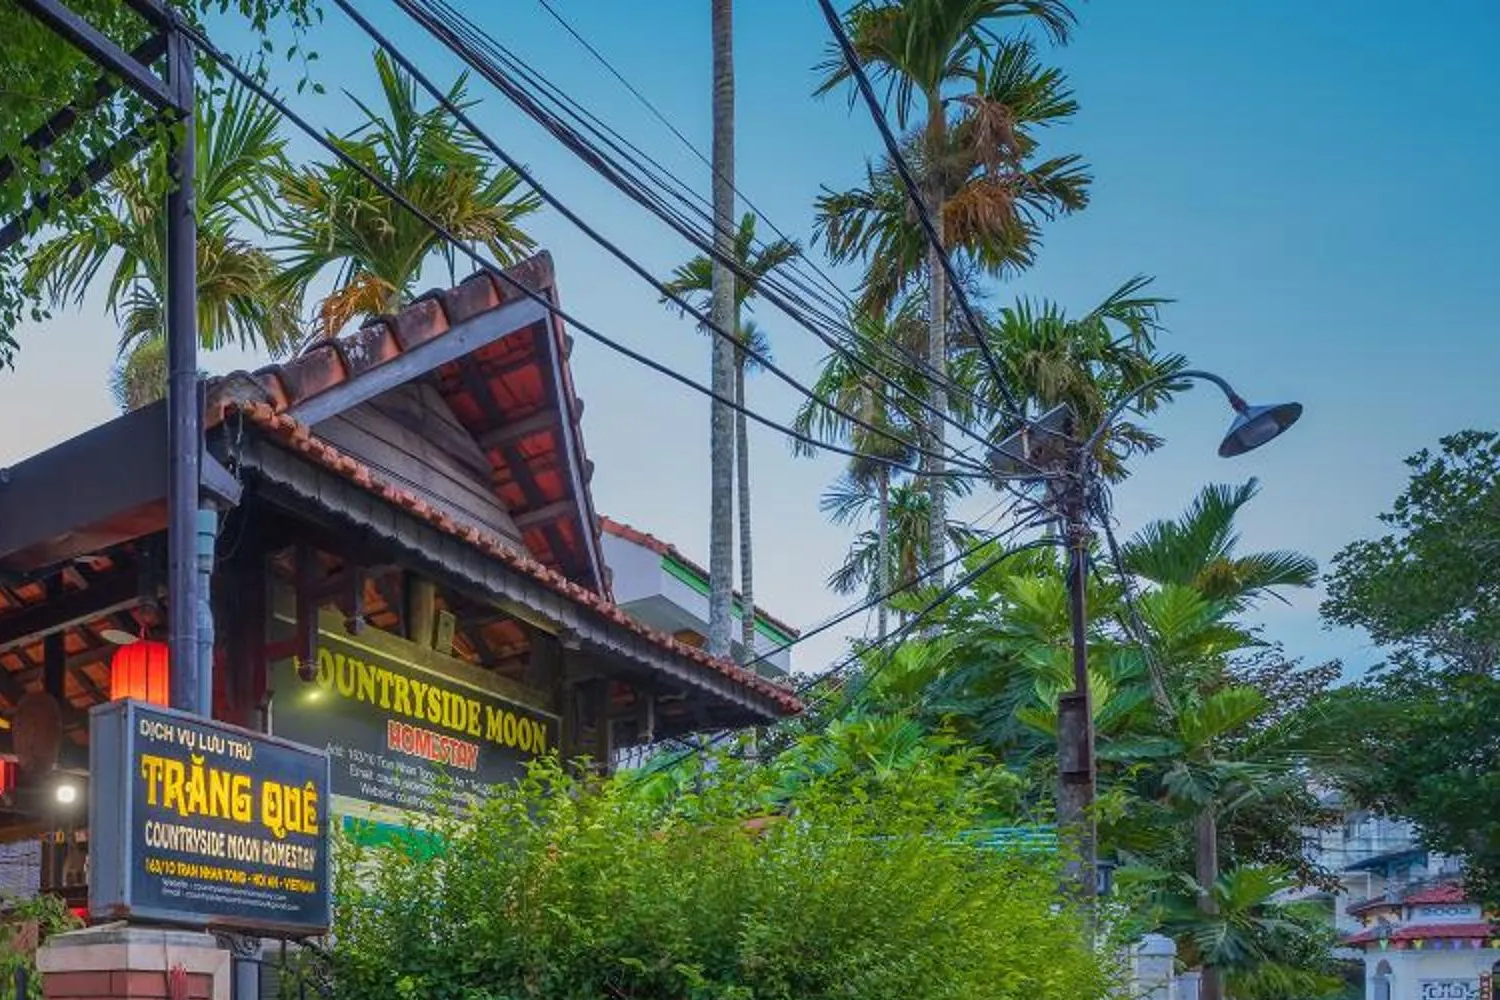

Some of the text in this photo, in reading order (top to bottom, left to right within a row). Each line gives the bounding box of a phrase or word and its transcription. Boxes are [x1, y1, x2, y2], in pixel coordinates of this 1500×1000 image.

[140, 719, 174, 743] DỊCH
[177, 727, 196, 751] VỤ
[293, 648, 547, 753] OUNTRYSIDE MOON
[141, 753, 252, 823] TRĂNG
[262, 780, 319, 839] QUÊ
[144, 820, 317, 872] COUNTRYSIDE MOON HOMESTAY
